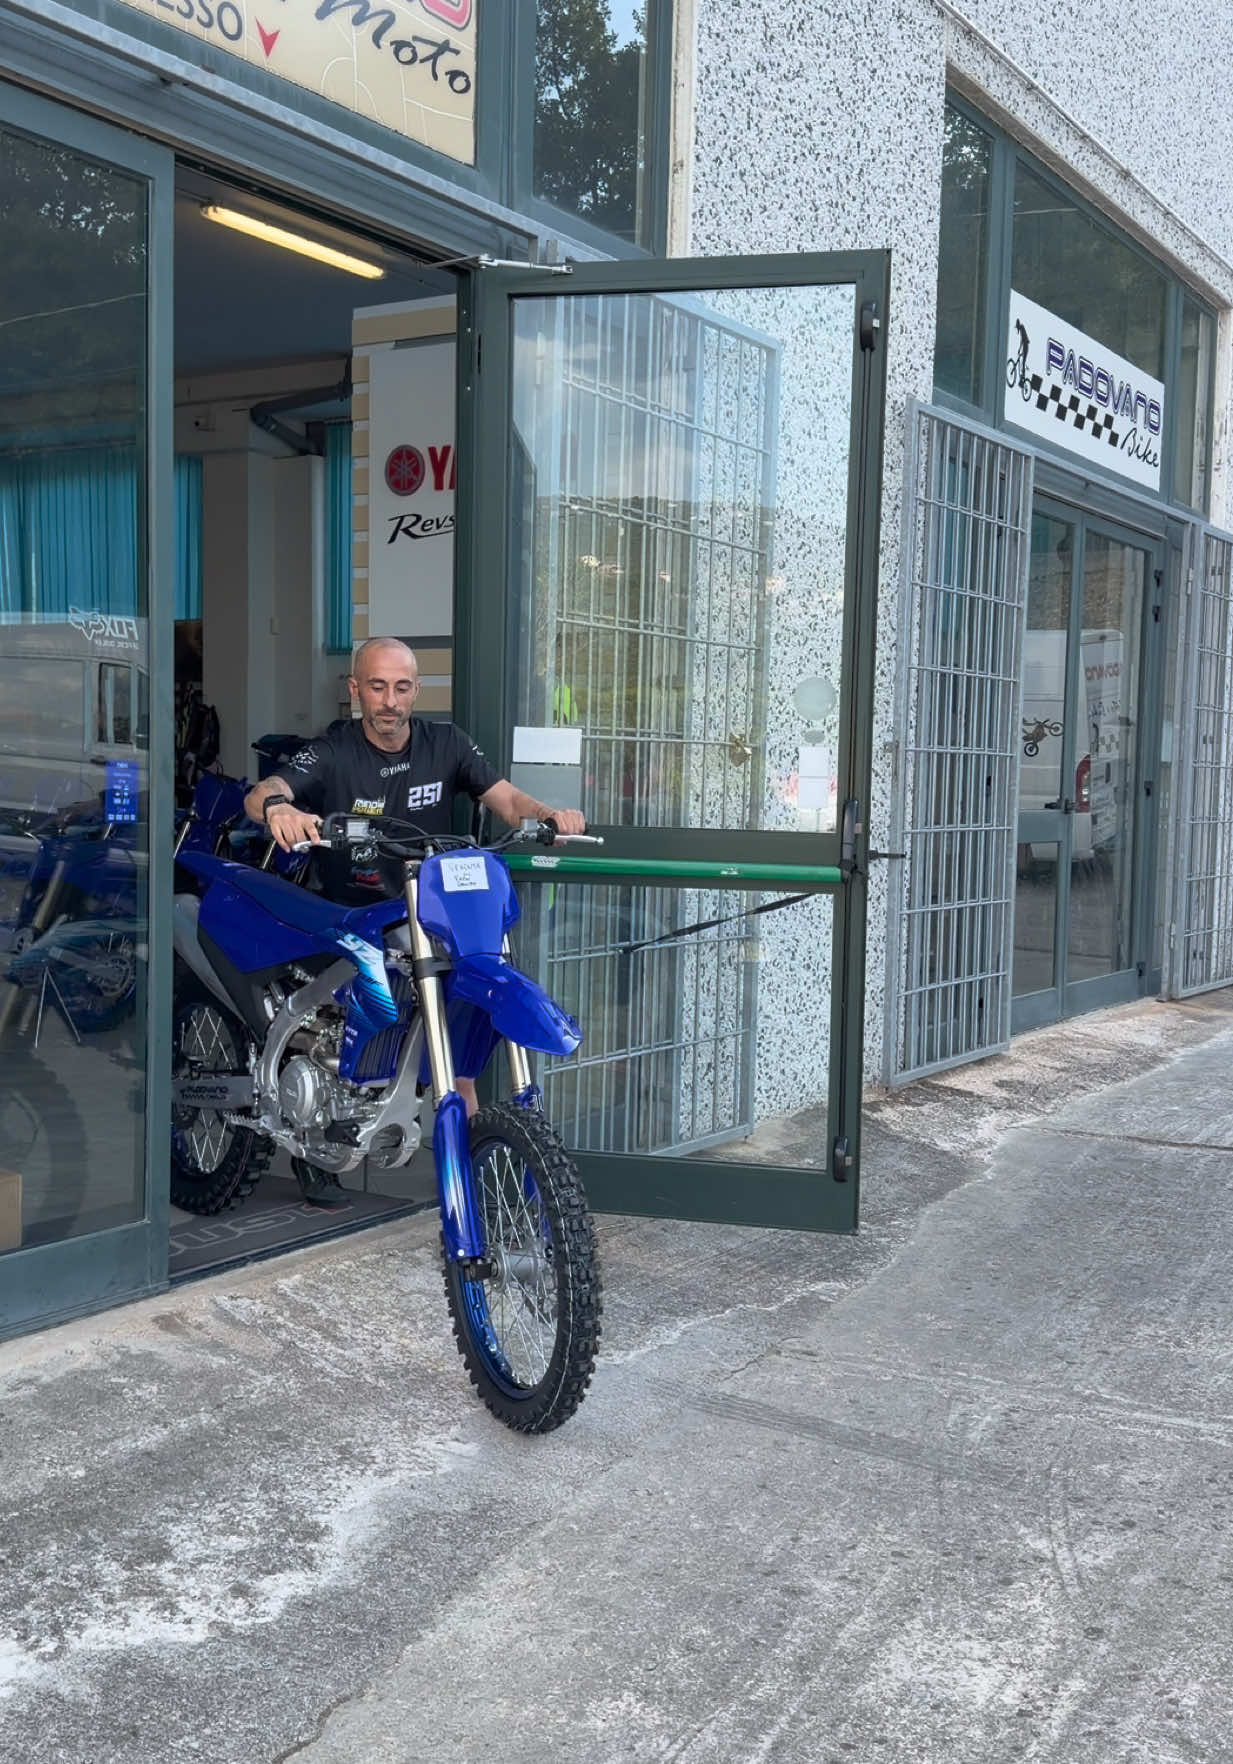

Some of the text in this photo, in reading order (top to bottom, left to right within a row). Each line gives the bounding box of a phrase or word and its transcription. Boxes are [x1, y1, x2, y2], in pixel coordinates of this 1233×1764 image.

[1046, 337, 1161, 436] PADOVANO
[1120, 427, 1159, 468] Bike
[407, 781, 443, 809] 251
